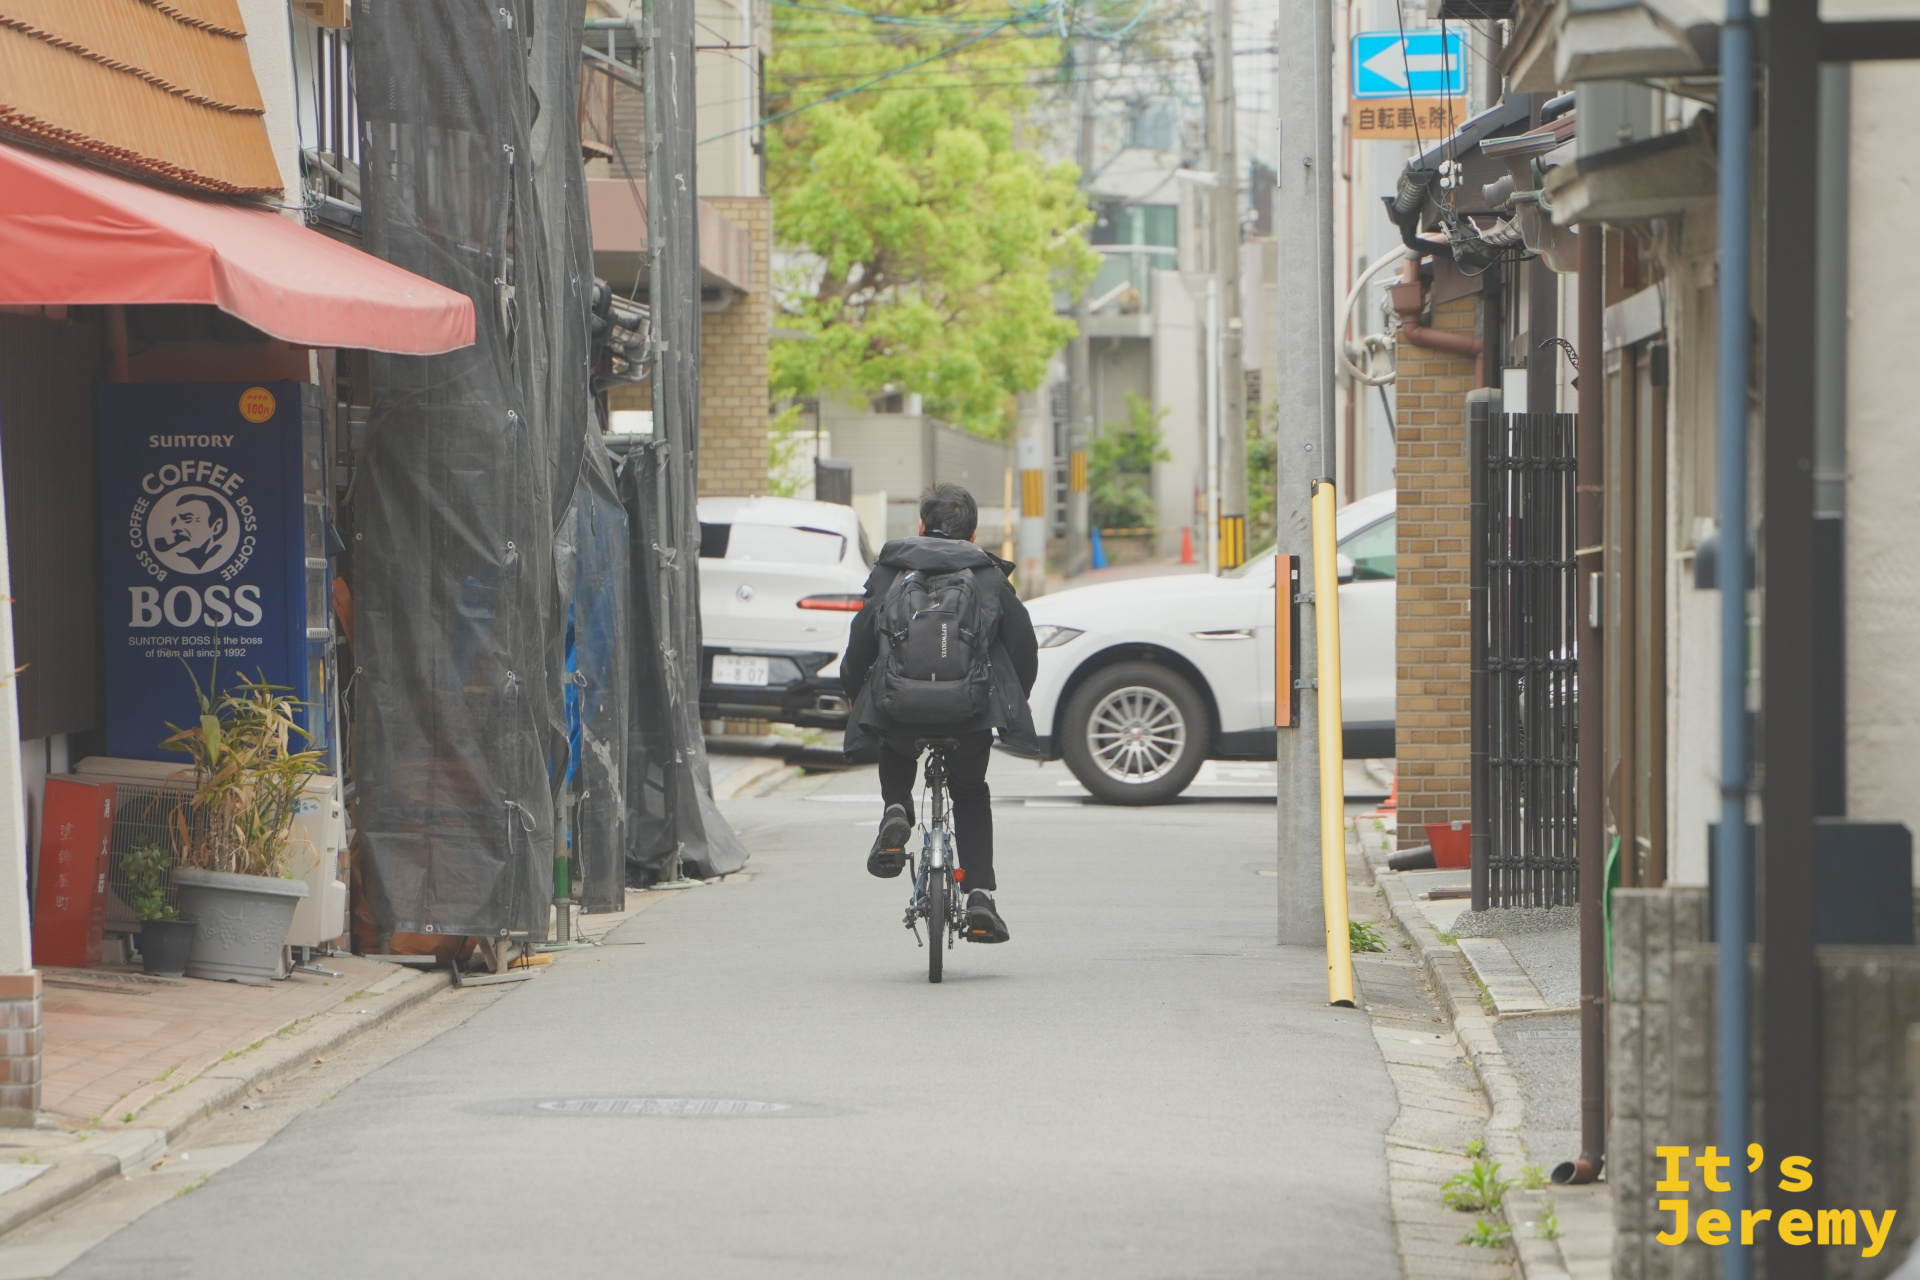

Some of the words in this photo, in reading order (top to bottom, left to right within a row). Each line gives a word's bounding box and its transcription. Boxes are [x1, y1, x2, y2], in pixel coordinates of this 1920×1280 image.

[1359, 106, 1460, 130] 自転車を除く
[142, 460, 245, 496] COFFEE
[129, 496, 150, 548] COFFEE
[236, 495, 257, 532] BOSS
[136, 550, 168, 582] BOSS
[220, 535, 256, 581] COFFEE
[128, 584, 263, 628] BOSS
[128, 636, 179, 646] SUNTORY
[181, 636, 211, 645] BOSS
[213, 636, 221, 645] is
[223, 636, 238, 645] the
[240, 636, 263, 645] boss
[145, 649, 155, 658] of
[156, 649, 180, 657] them
[182, 649, 194, 657] all
[196, 648, 221, 657] since
[224, 648, 246, 657] 1992
